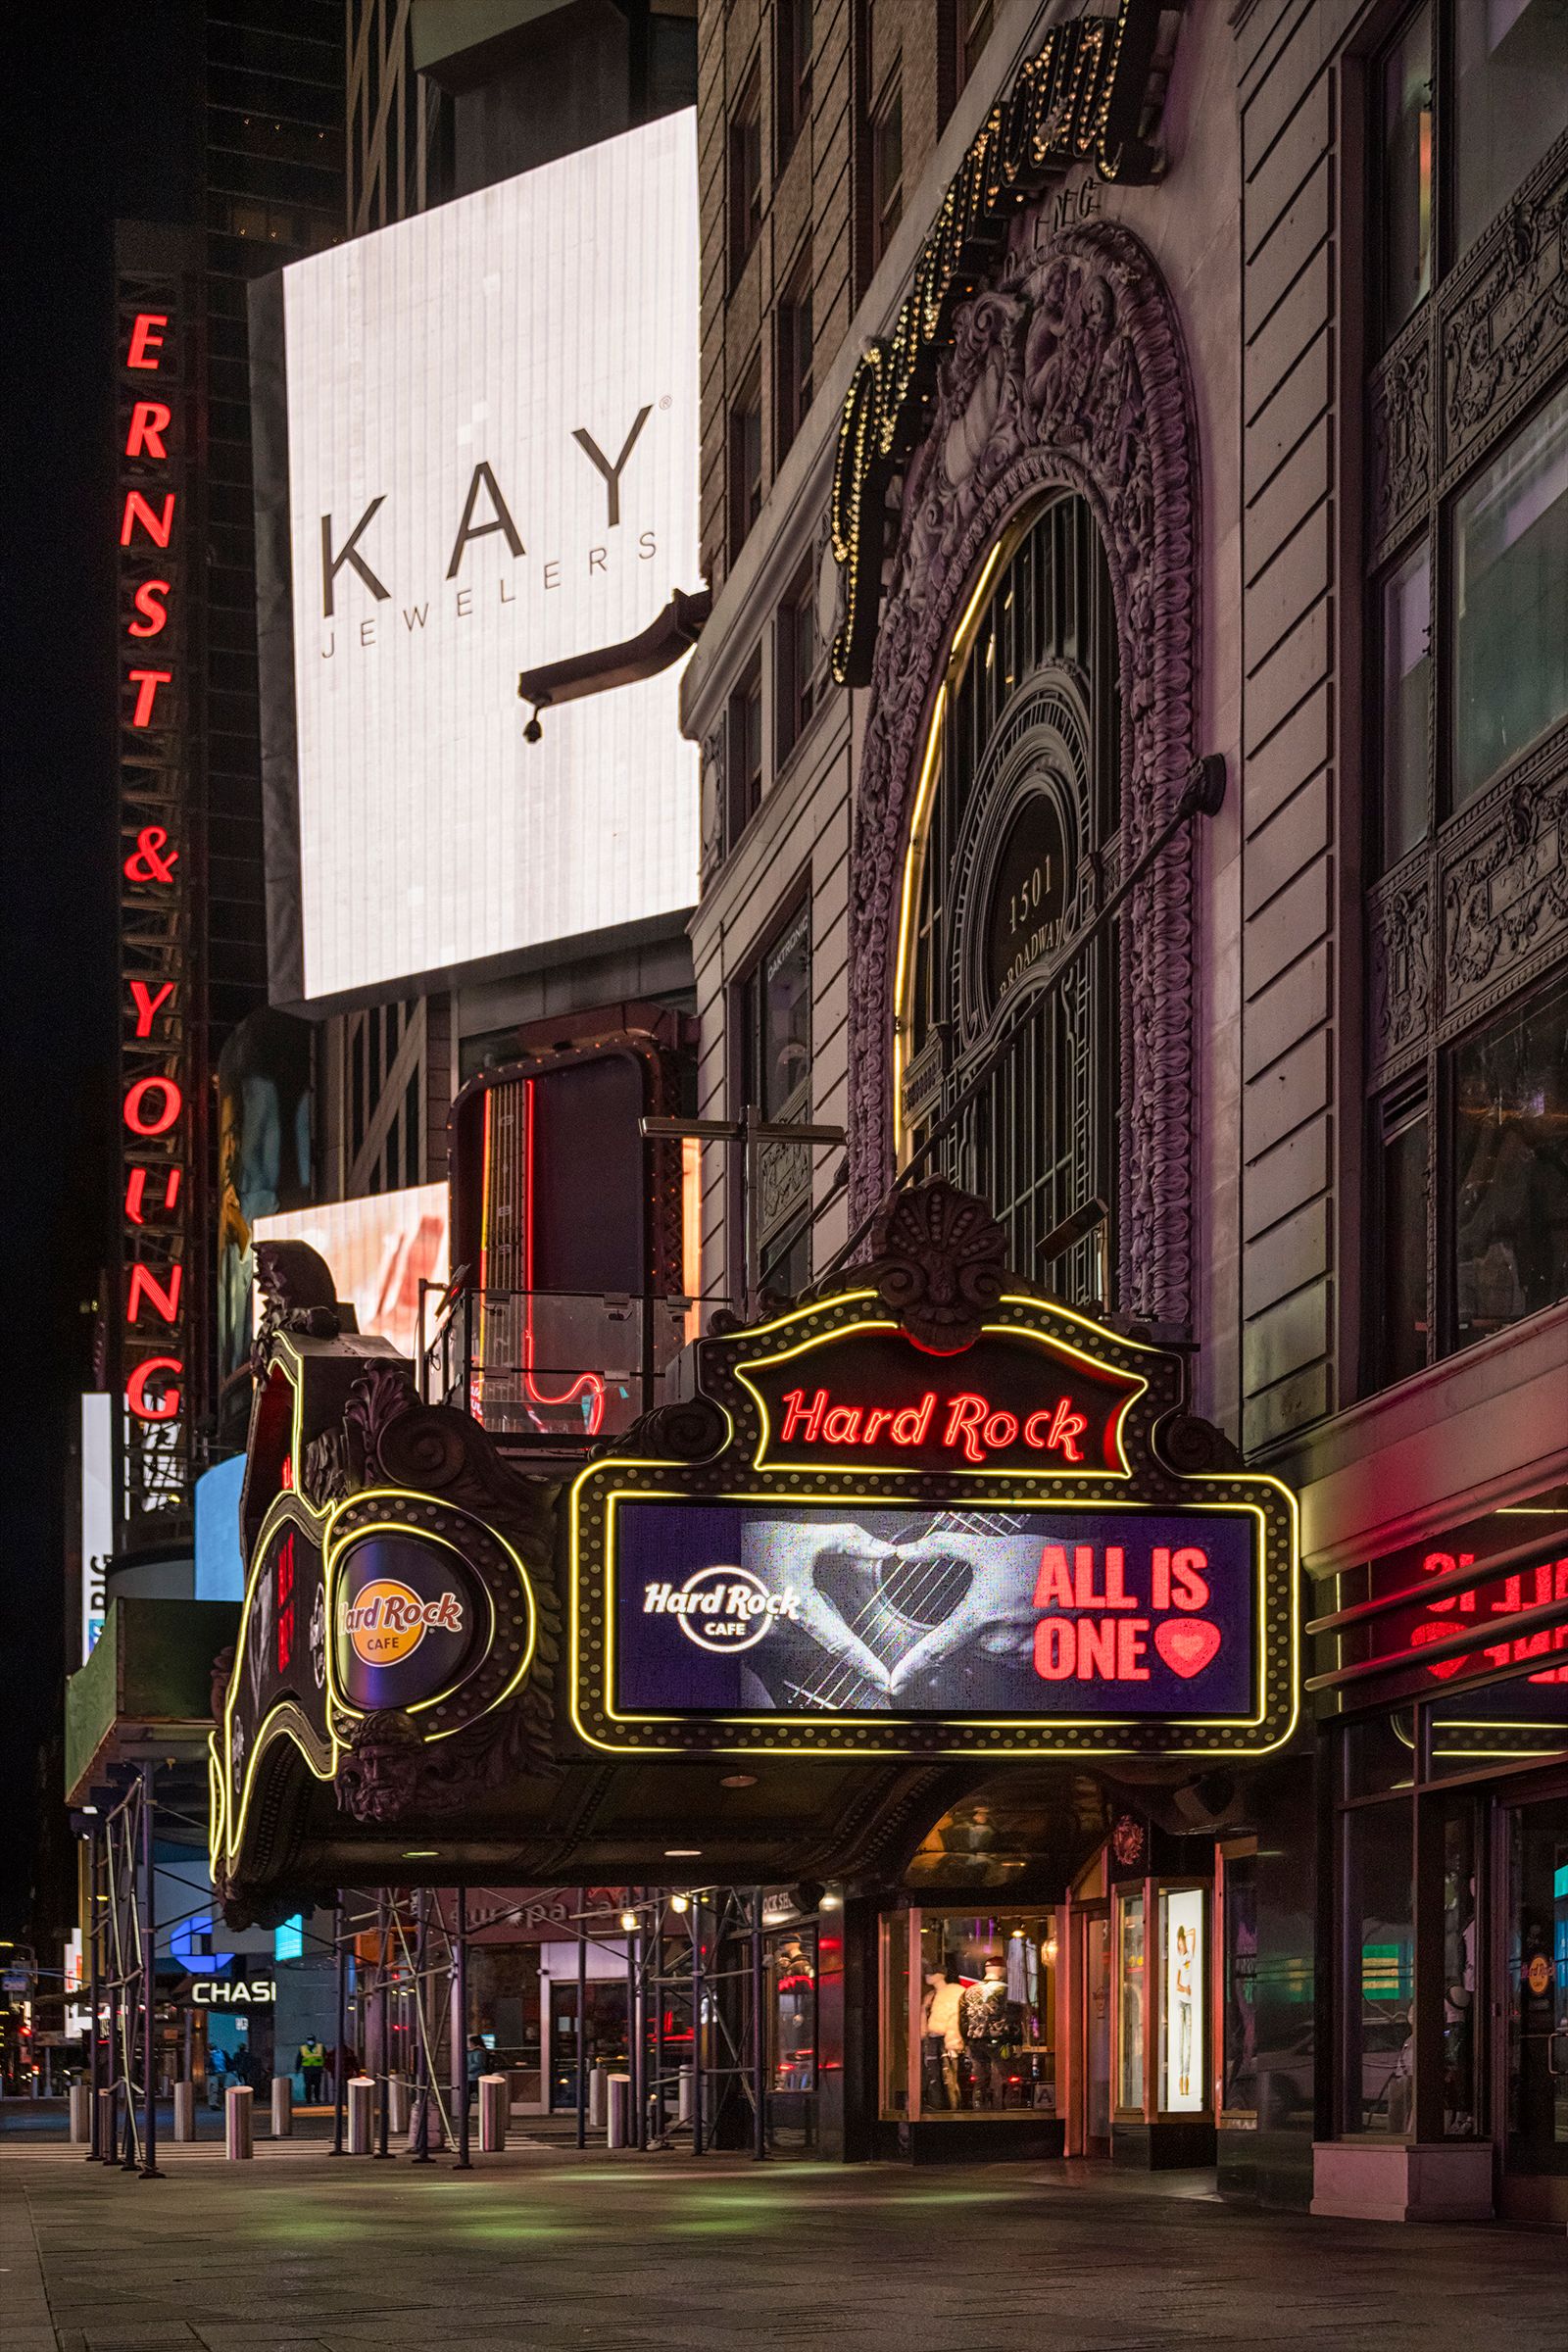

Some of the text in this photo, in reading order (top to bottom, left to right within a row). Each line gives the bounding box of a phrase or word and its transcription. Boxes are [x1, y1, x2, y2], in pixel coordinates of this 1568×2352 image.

[320, 404, 654, 618] KAY
[320, 531, 658, 659] JEWELERS
[121, 313, 183, 1420] ERNST & YOUNG
[1008, 855, 1052, 935] 1501
[781, 1389, 1086, 1462] Hard Rock
[643, 1583, 801, 1621] Hard Rock
[1032, 1545, 1210, 1611] ALL IS
[367, 1638, 400, 1651] CAFE
[382, 1592, 463, 1633] Rock
[704, 1621, 747, 1636] CAFE
[1033, 1616, 1151, 1681] ONE
